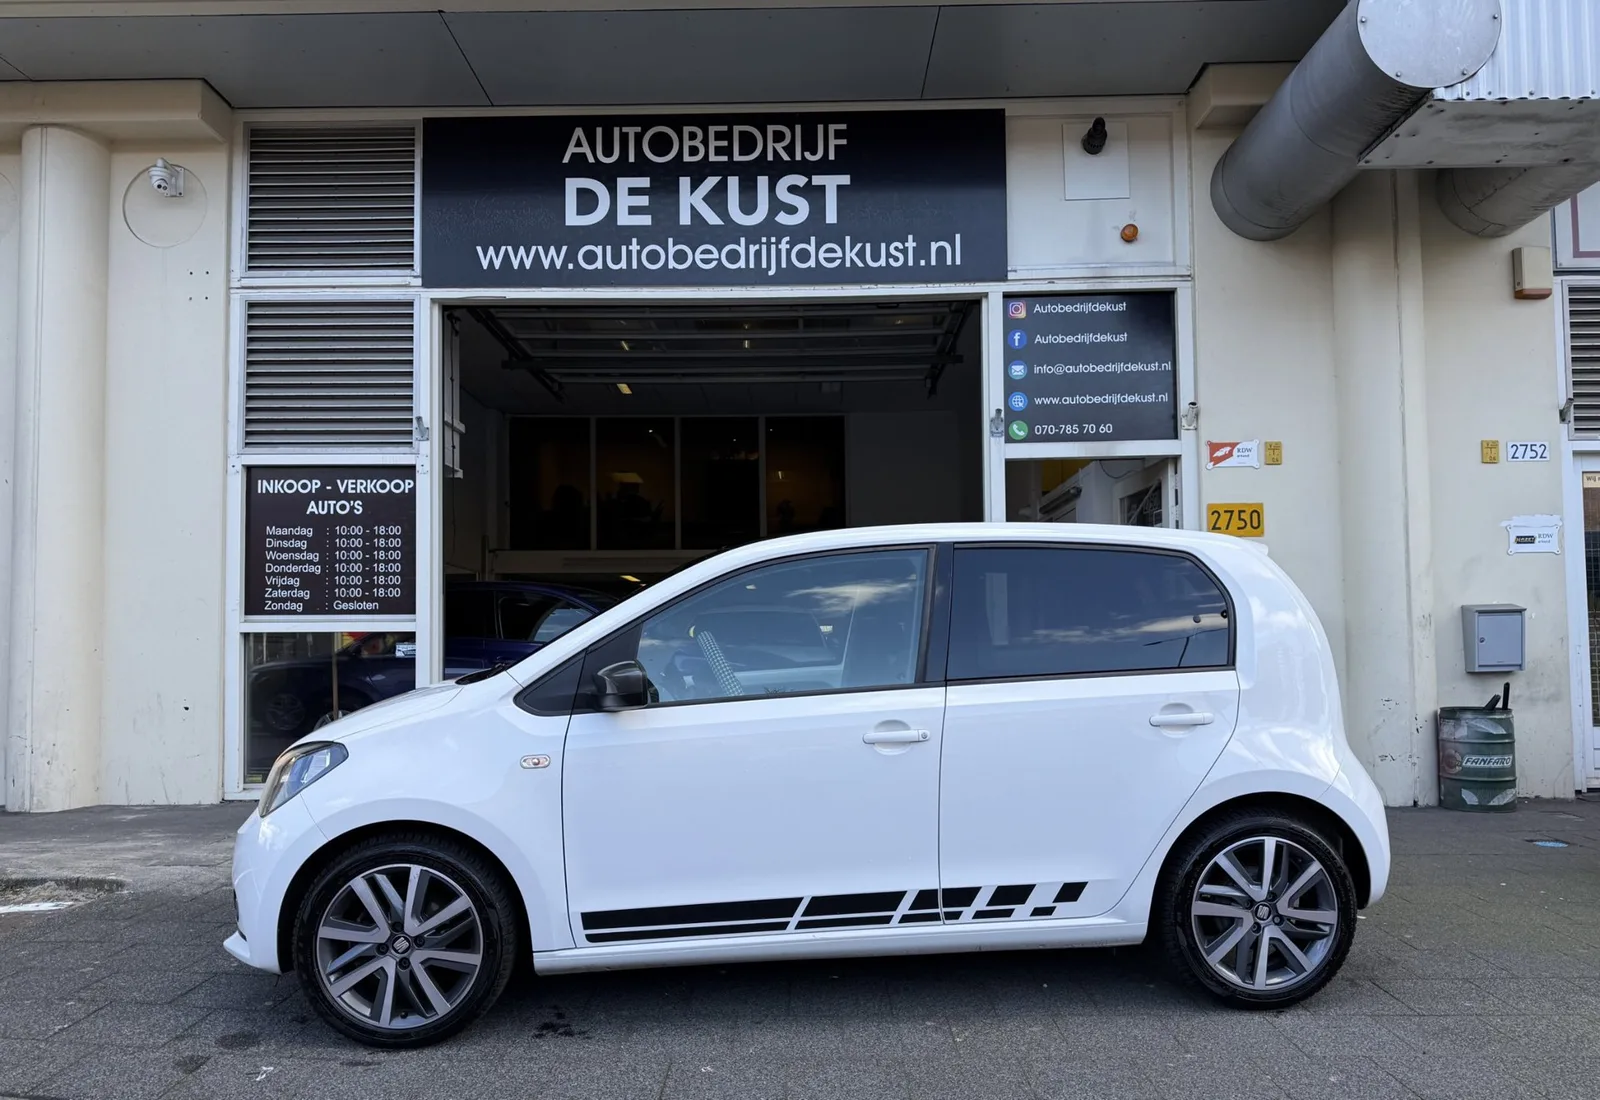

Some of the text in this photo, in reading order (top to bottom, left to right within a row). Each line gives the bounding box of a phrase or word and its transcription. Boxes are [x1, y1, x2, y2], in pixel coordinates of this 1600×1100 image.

[562, 123, 848, 164] AUTOBEDRIJF
[564, 174, 851, 226] DE KUST
[475, 233, 961, 276] www.autobedrijfdekust.nl
[1033, 301, 1127, 314] Autobedrijfdekust
[1034, 332, 1128, 345] Autobedrijfdekust
[1033, 361, 1172, 375] info@autobedrijfdekust.nl
[1034, 392, 1169, 405] www.autobedrijfdekust.nl
[1034, 423, 1113, 435] 070-785 70 60
[1510, 443, 1547, 460] 2752
[257, 479, 321, 494] INKOOP
[336, 479, 415, 494] VERKOOP
[306, 500, 363, 515] AUTO'S
[1210, 509, 1261, 531] 2750
[266, 525, 313, 537] Maandag
[334, 525, 363, 536] 10:00
[373, 525, 402, 536] 18:00
[265, 538, 308, 550] Dinsdag
[334, 537, 363, 548] 10:00
[373, 537, 402, 548] 18:00
[265, 551, 319, 562] Woensdag
[334, 550, 363, 561] 10:00
[373, 550, 402, 561] 18:00
[265, 563, 321, 575] Donderdag
[334, 562, 363, 573] 10:00
[373, 562, 402, 573] 18:00
[264, 575, 300, 587] Vrijdag
[334, 575, 363, 586] 10:00
[373, 575, 402, 586] 18:00
[264, 588, 310, 600] Zaterdag
[334, 587, 363, 598] 10:00
[373, 587, 402, 598] 18:00
[264, 600, 303, 612] Zondag
[333, 600, 379, 610] Gesloten
[1464, 757, 1511, 766] FANFARO
